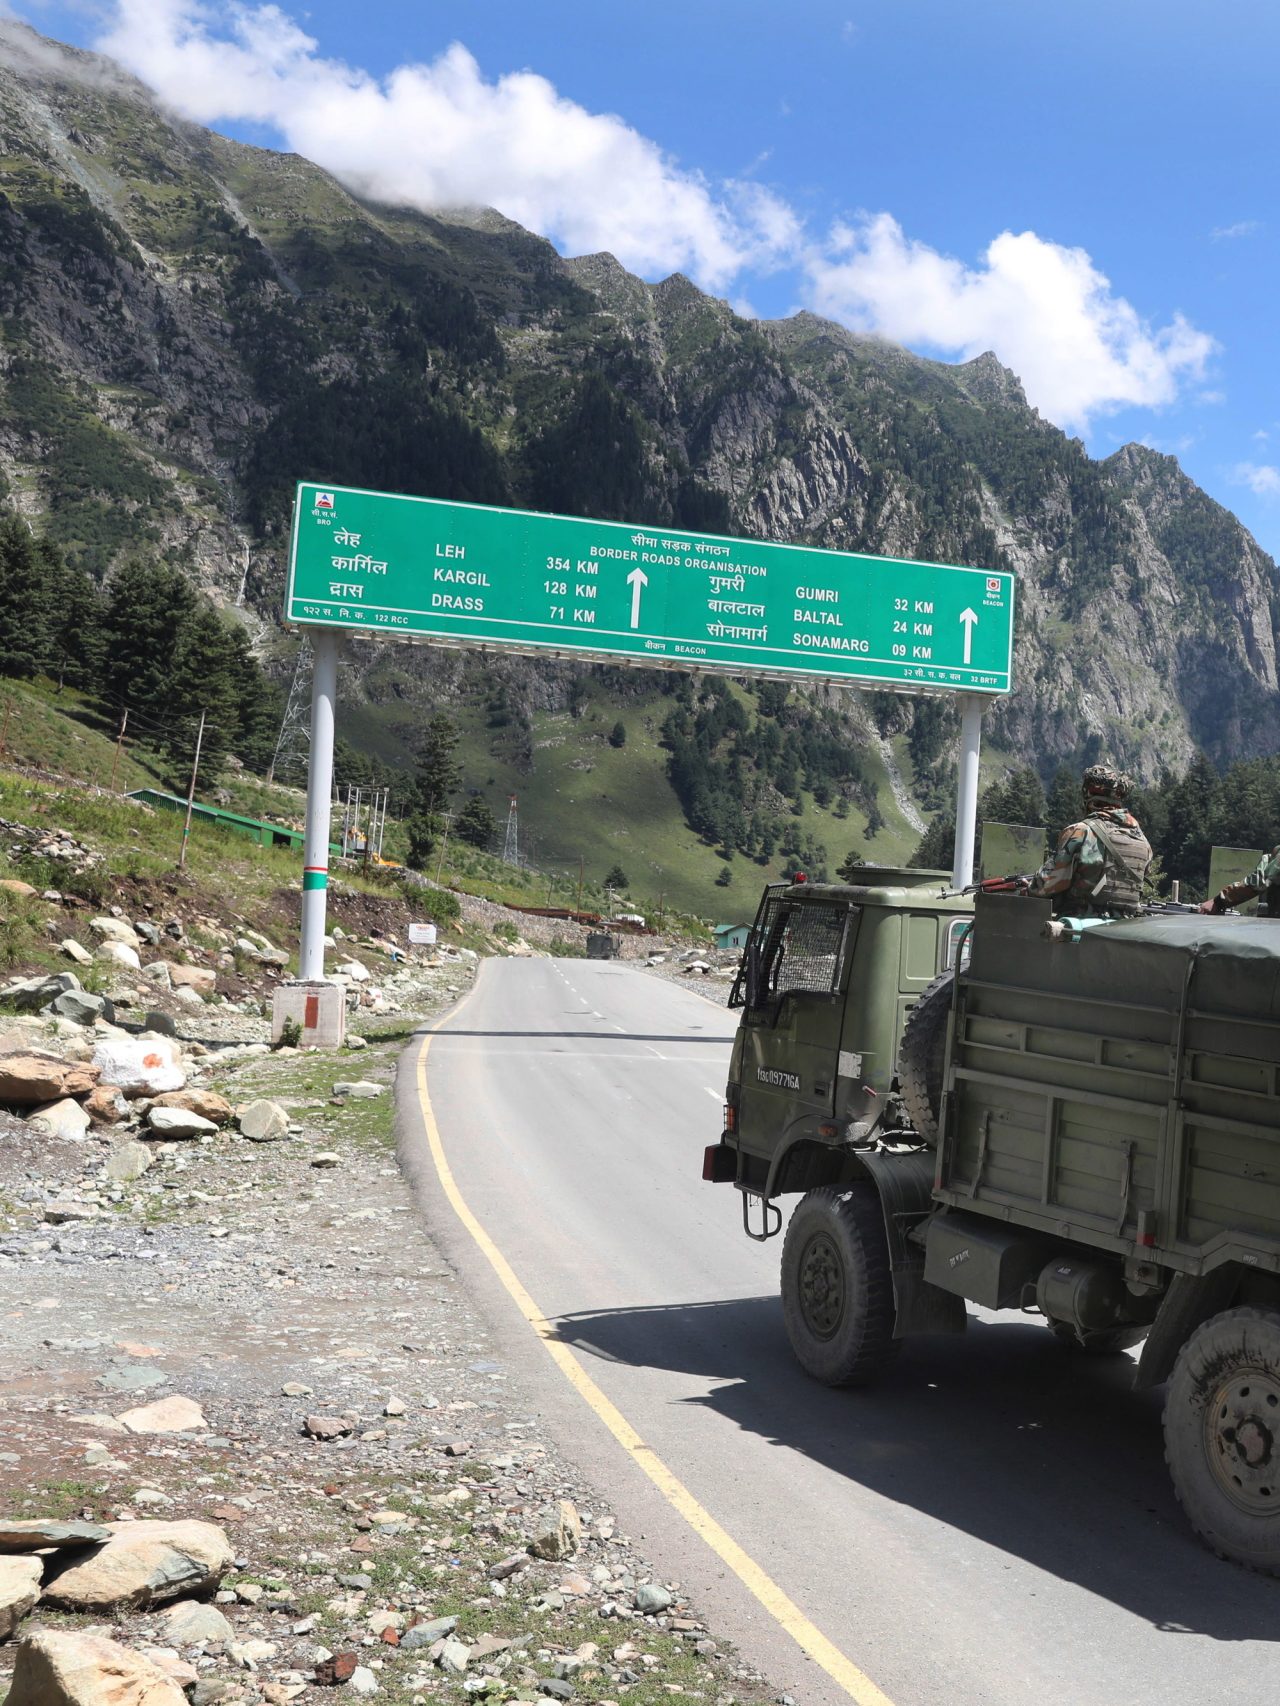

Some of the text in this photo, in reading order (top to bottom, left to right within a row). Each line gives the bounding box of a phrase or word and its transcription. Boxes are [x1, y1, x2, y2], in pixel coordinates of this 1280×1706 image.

[316, 518, 332, 526] BRO
[333, 526, 361, 548] लेह
[630, 532, 730, 557] सीमा सड़क संगठन
[435, 543, 465, 560] LEH
[330, 554, 388, 575] कार्गिल
[546, 556, 600, 575] 354 KM
[590, 546, 767, 577] BORDER ROADS ORGANISATION
[433, 568, 491, 588] KARGIL
[708, 574, 746, 594] गुमरी
[328, 582, 364, 598] द्रास
[543, 581, 597, 599] 128 KM
[795, 586, 839, 603] GUMRI
[431, 594, 484, 612] DRASS
[707, 598, 766, 618] बालटाल
[894, 598, 934, 614] 32 KM
[375, 614, 408, 624] 122 RCC
[549, 606, 596, 624] 71 KM
[794, 608, 844, 626] BALTAL
[706, 619, 768, 642] सोनामार्ग
[893, 620, 933, 636] 24 KM
[644, 640, 666, 651] बीकन
[675, 644, 706, 655] BEACON
[792, 633, 870, 652] SONAMARG
[892, 644, 932, 660] 09 KM
[980, 676, 998, 684] BRTF
